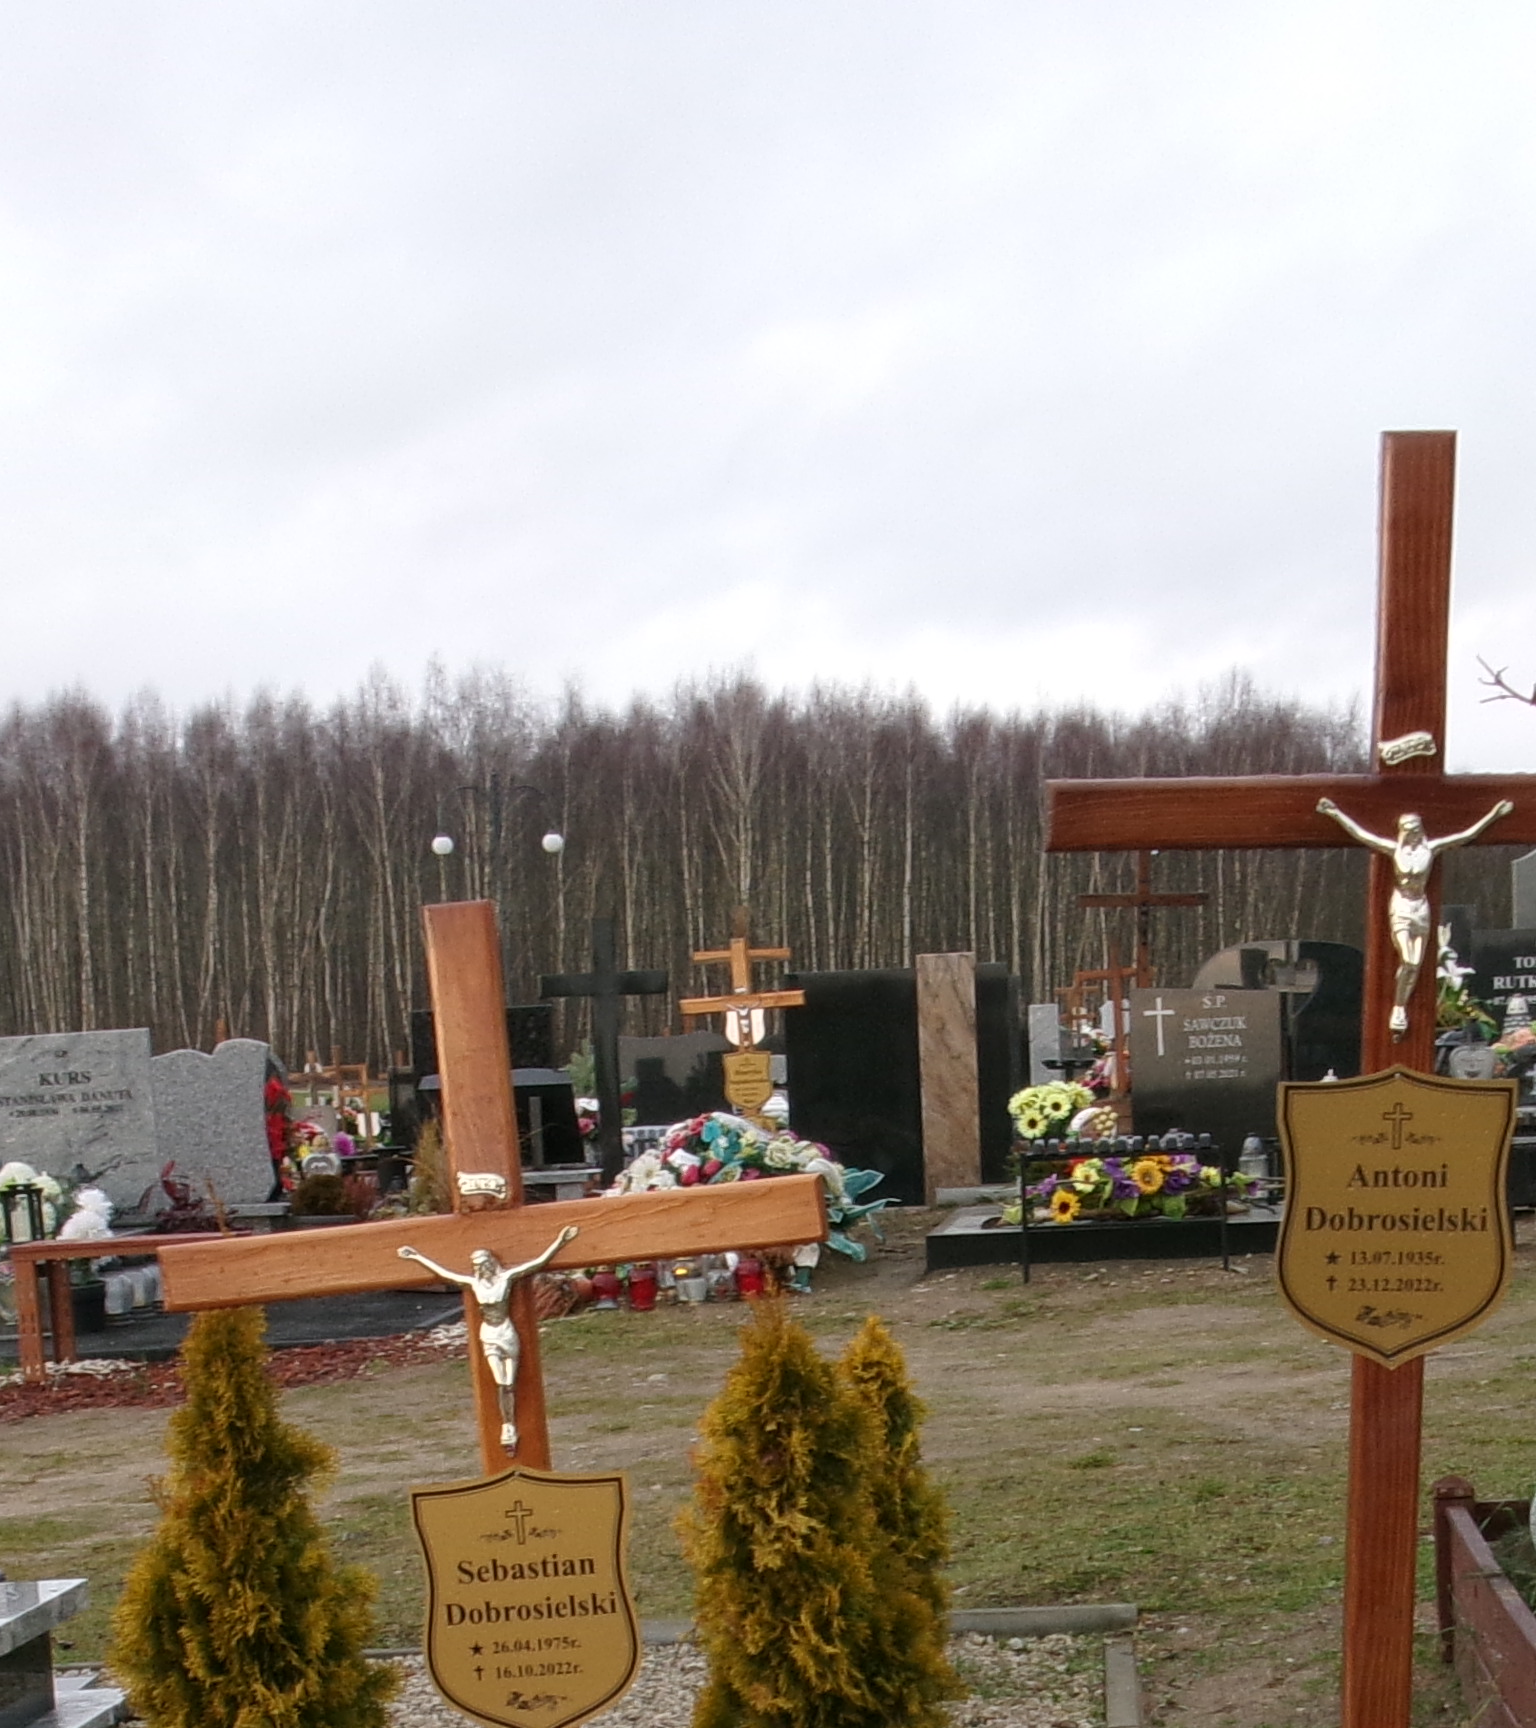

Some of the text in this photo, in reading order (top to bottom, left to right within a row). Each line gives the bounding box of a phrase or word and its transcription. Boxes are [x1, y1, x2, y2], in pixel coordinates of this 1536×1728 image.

[1183, 1016, 1248, 1032] SAWCZUK
[39, 1071, 92, 1087] KURS
[1347, 1163, 1448, 1188] Antoni
[1305, 1207, 1488, 1232] Dobrosielski
[456, 1554, 596, 1585] Sebastian
[445, 1592, 617, 1627] Dobrosielski
